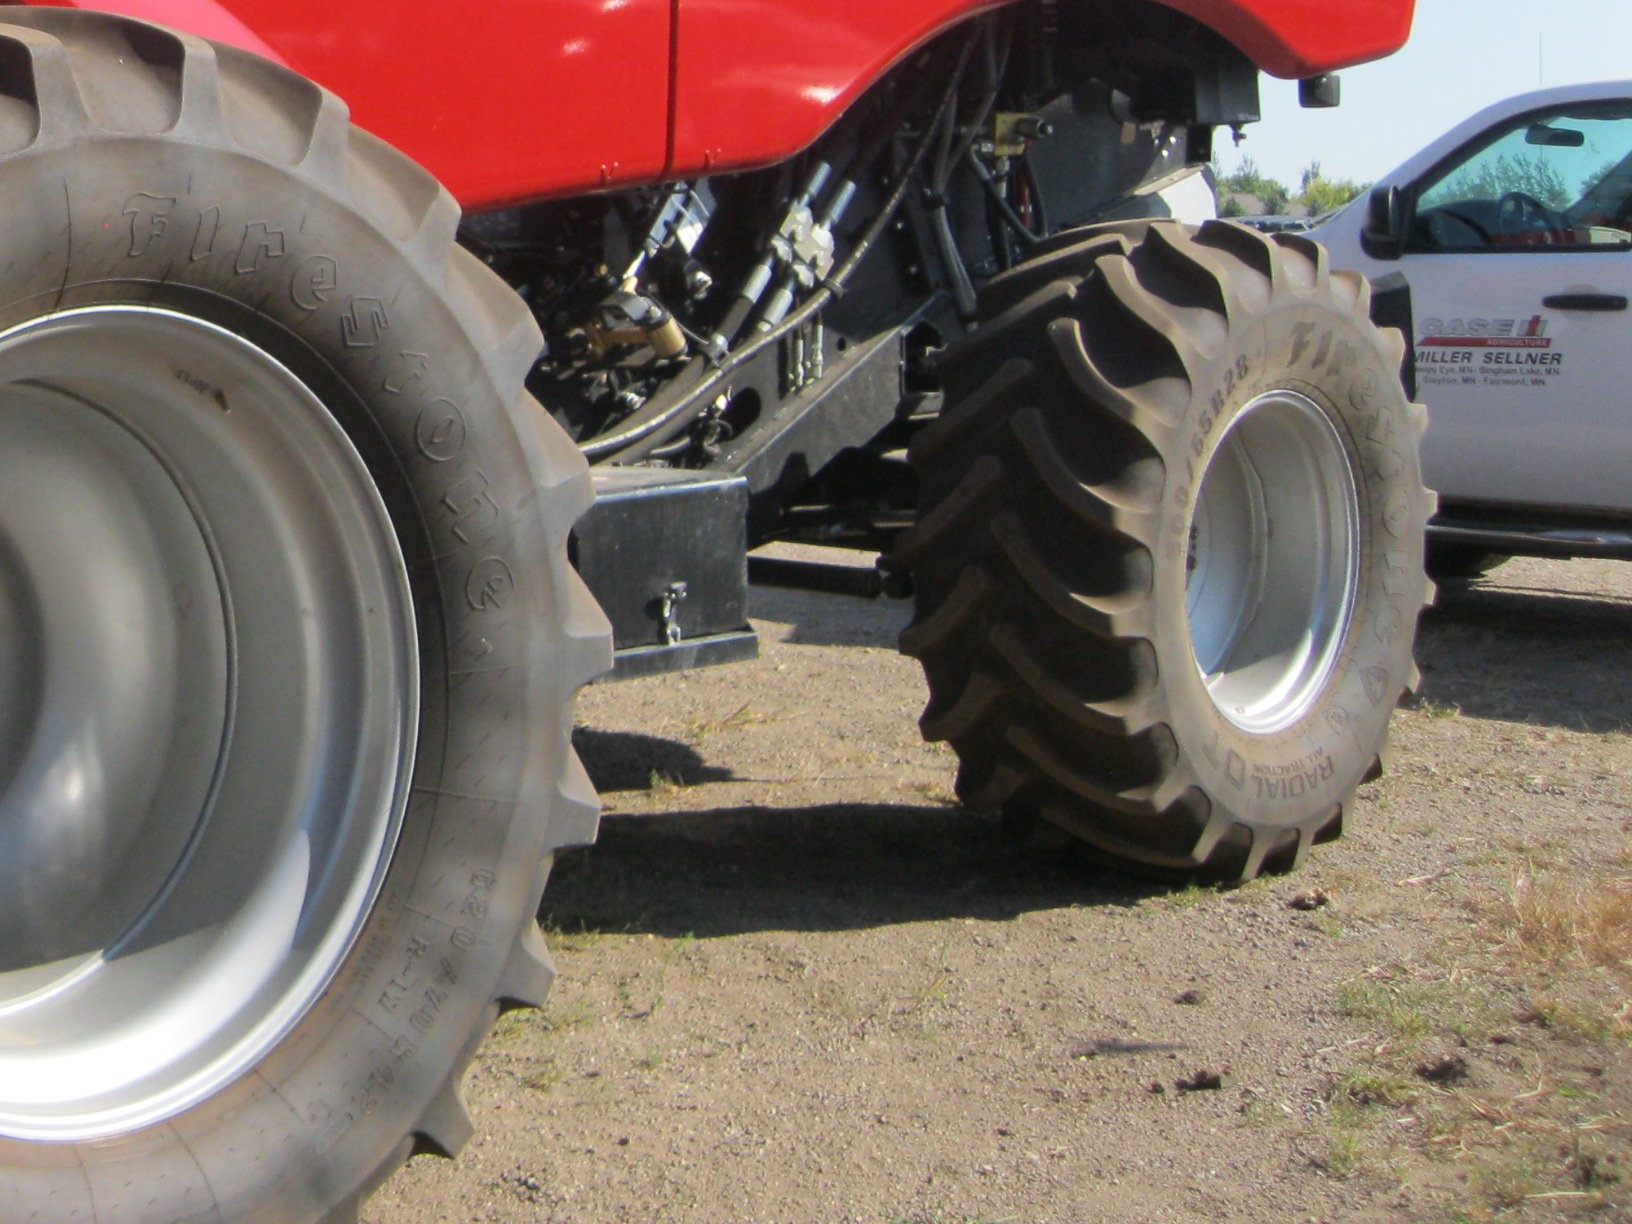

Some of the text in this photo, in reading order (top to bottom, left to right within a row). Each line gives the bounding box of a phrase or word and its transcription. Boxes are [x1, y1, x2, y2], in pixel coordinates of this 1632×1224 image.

[1419, 317, 1515, 337] CASE
[1486, 338, 1548, 347] AGRICULTURE
[1483, 352, 1563, 365] SELLNER
[1479, 366, 1518, 376] Bingham
[1422, 376, 1460, 386] Slayton,
[1483, 376, 1528, 386] Fairmont,
[1251, 755, 1335, 800] RADIAL
